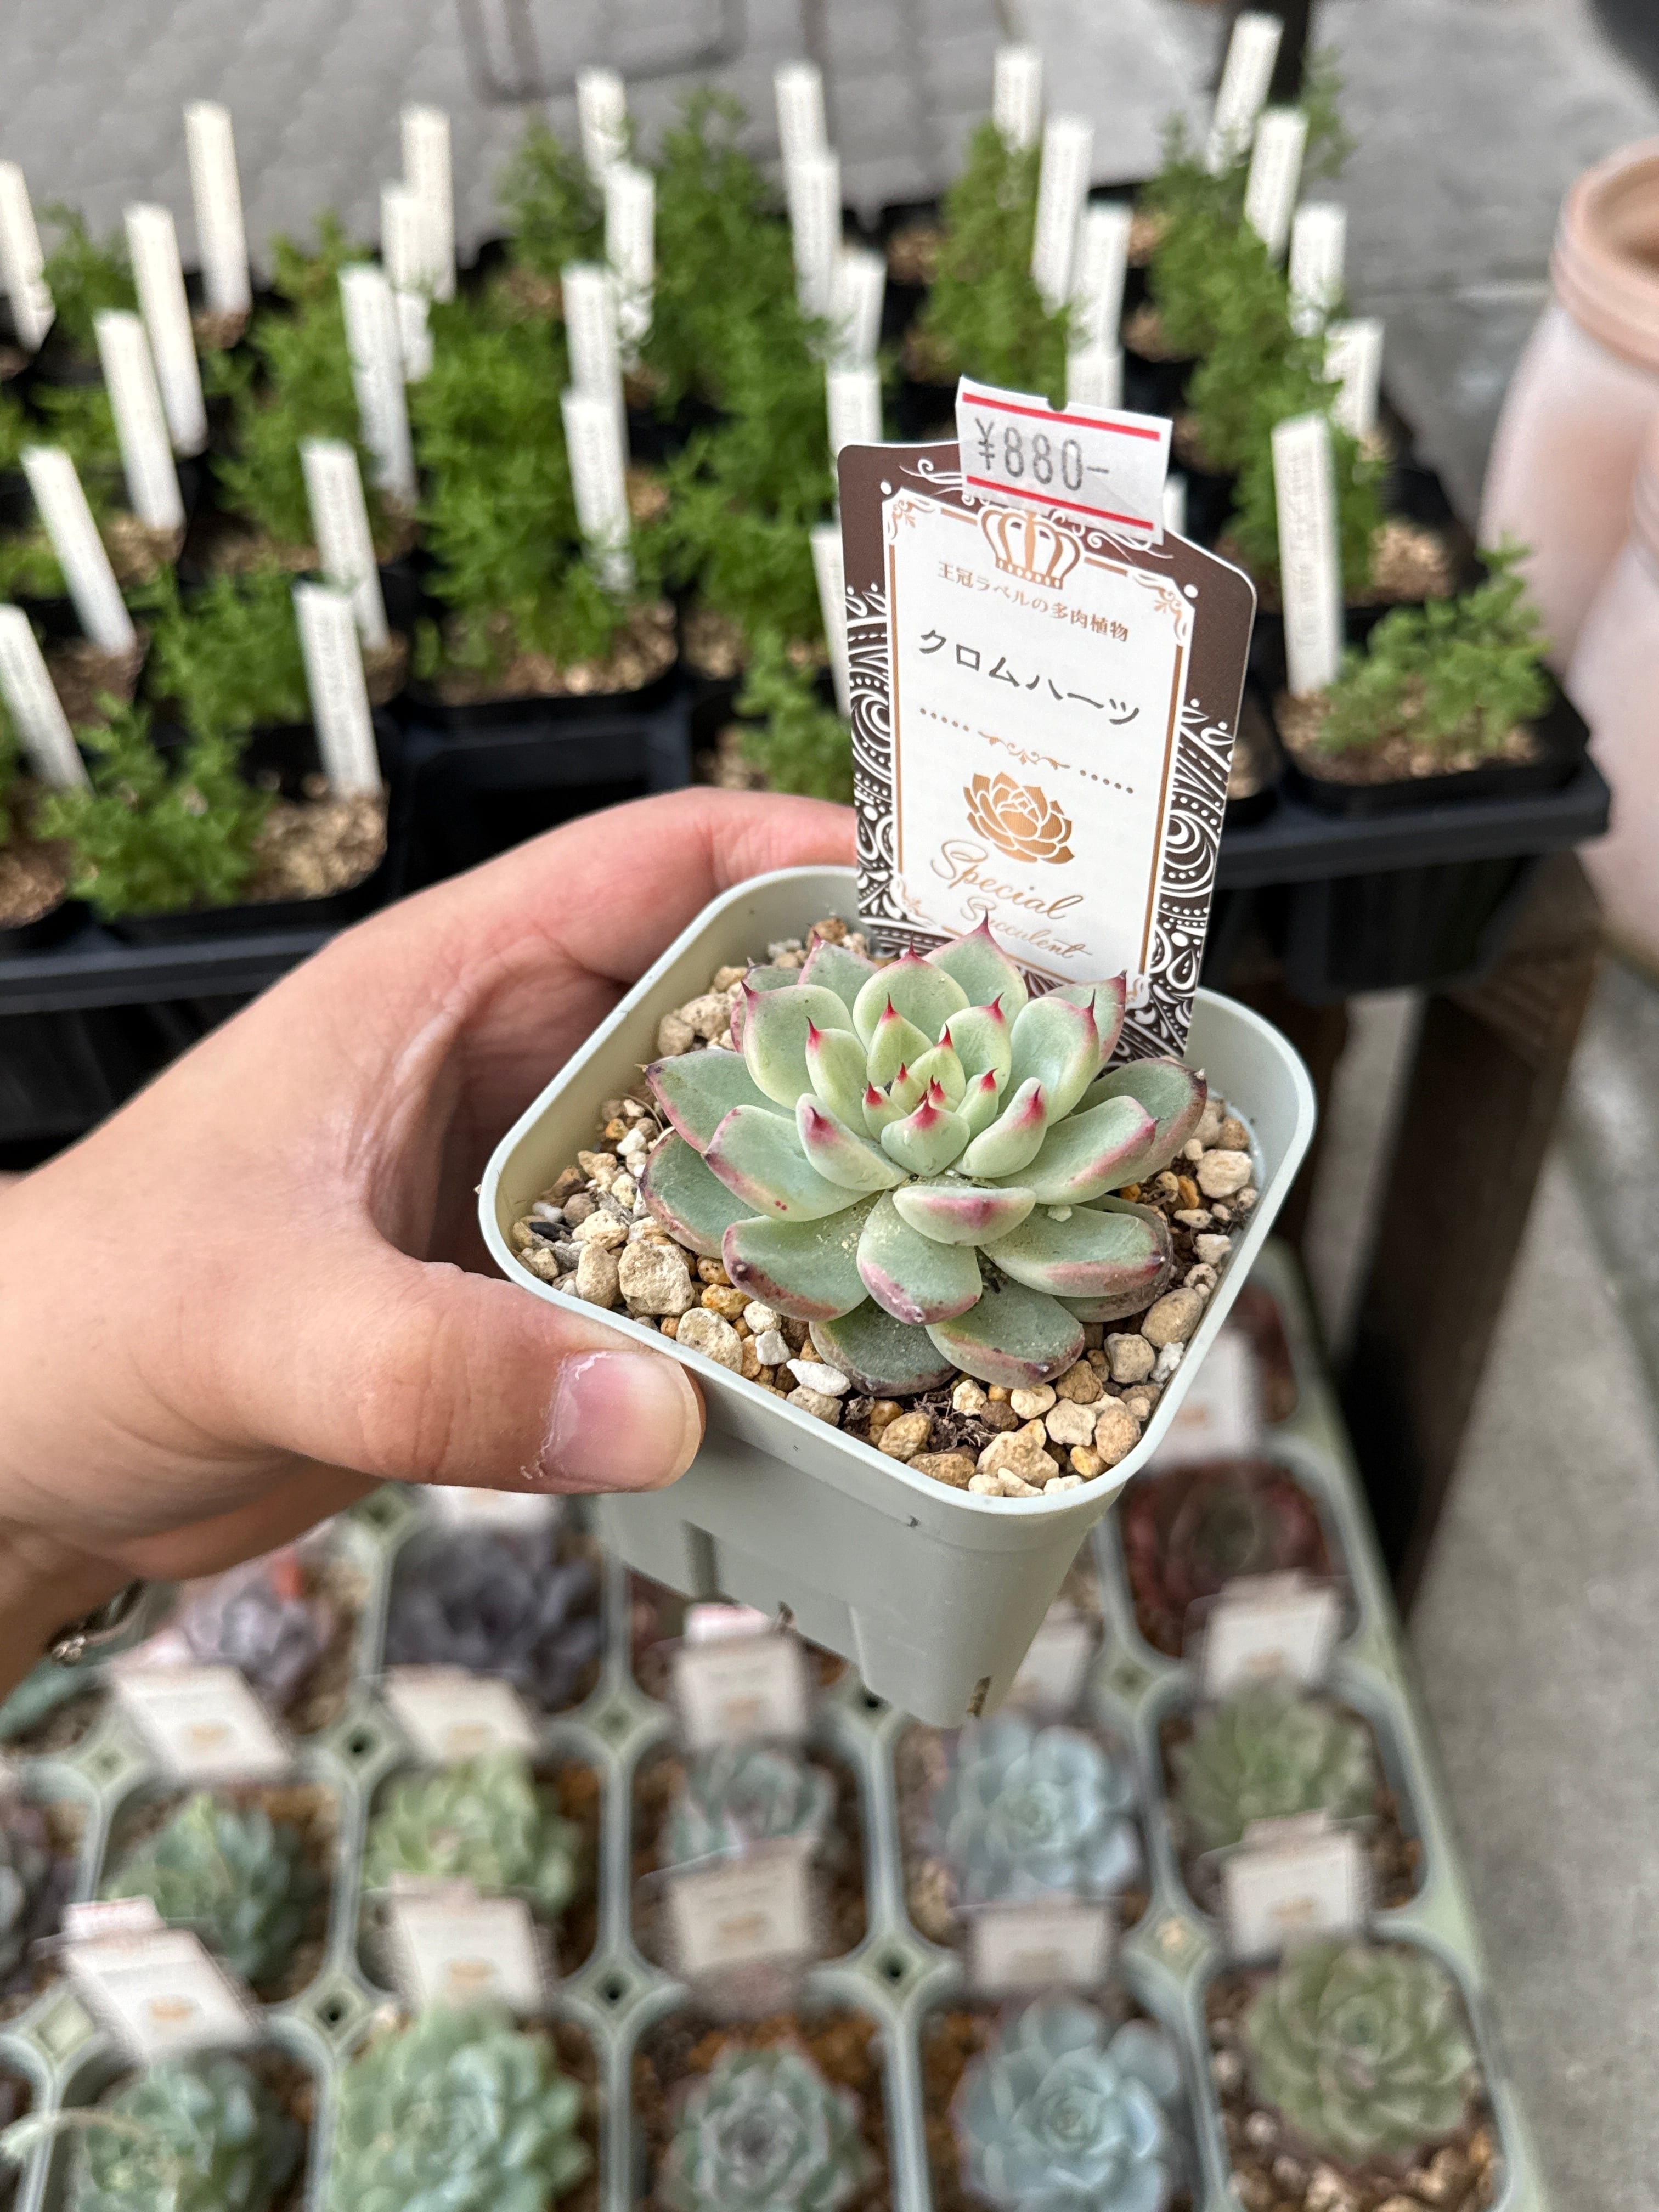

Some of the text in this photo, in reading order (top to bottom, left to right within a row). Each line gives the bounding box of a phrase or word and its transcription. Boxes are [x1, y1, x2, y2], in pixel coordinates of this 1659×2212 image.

[938, 560, 1129, 642] 王冠ラベルの多肉植物
[918, 629, 1140, 725] クロムハーツ
[931, 840, 1084, 920] Special
